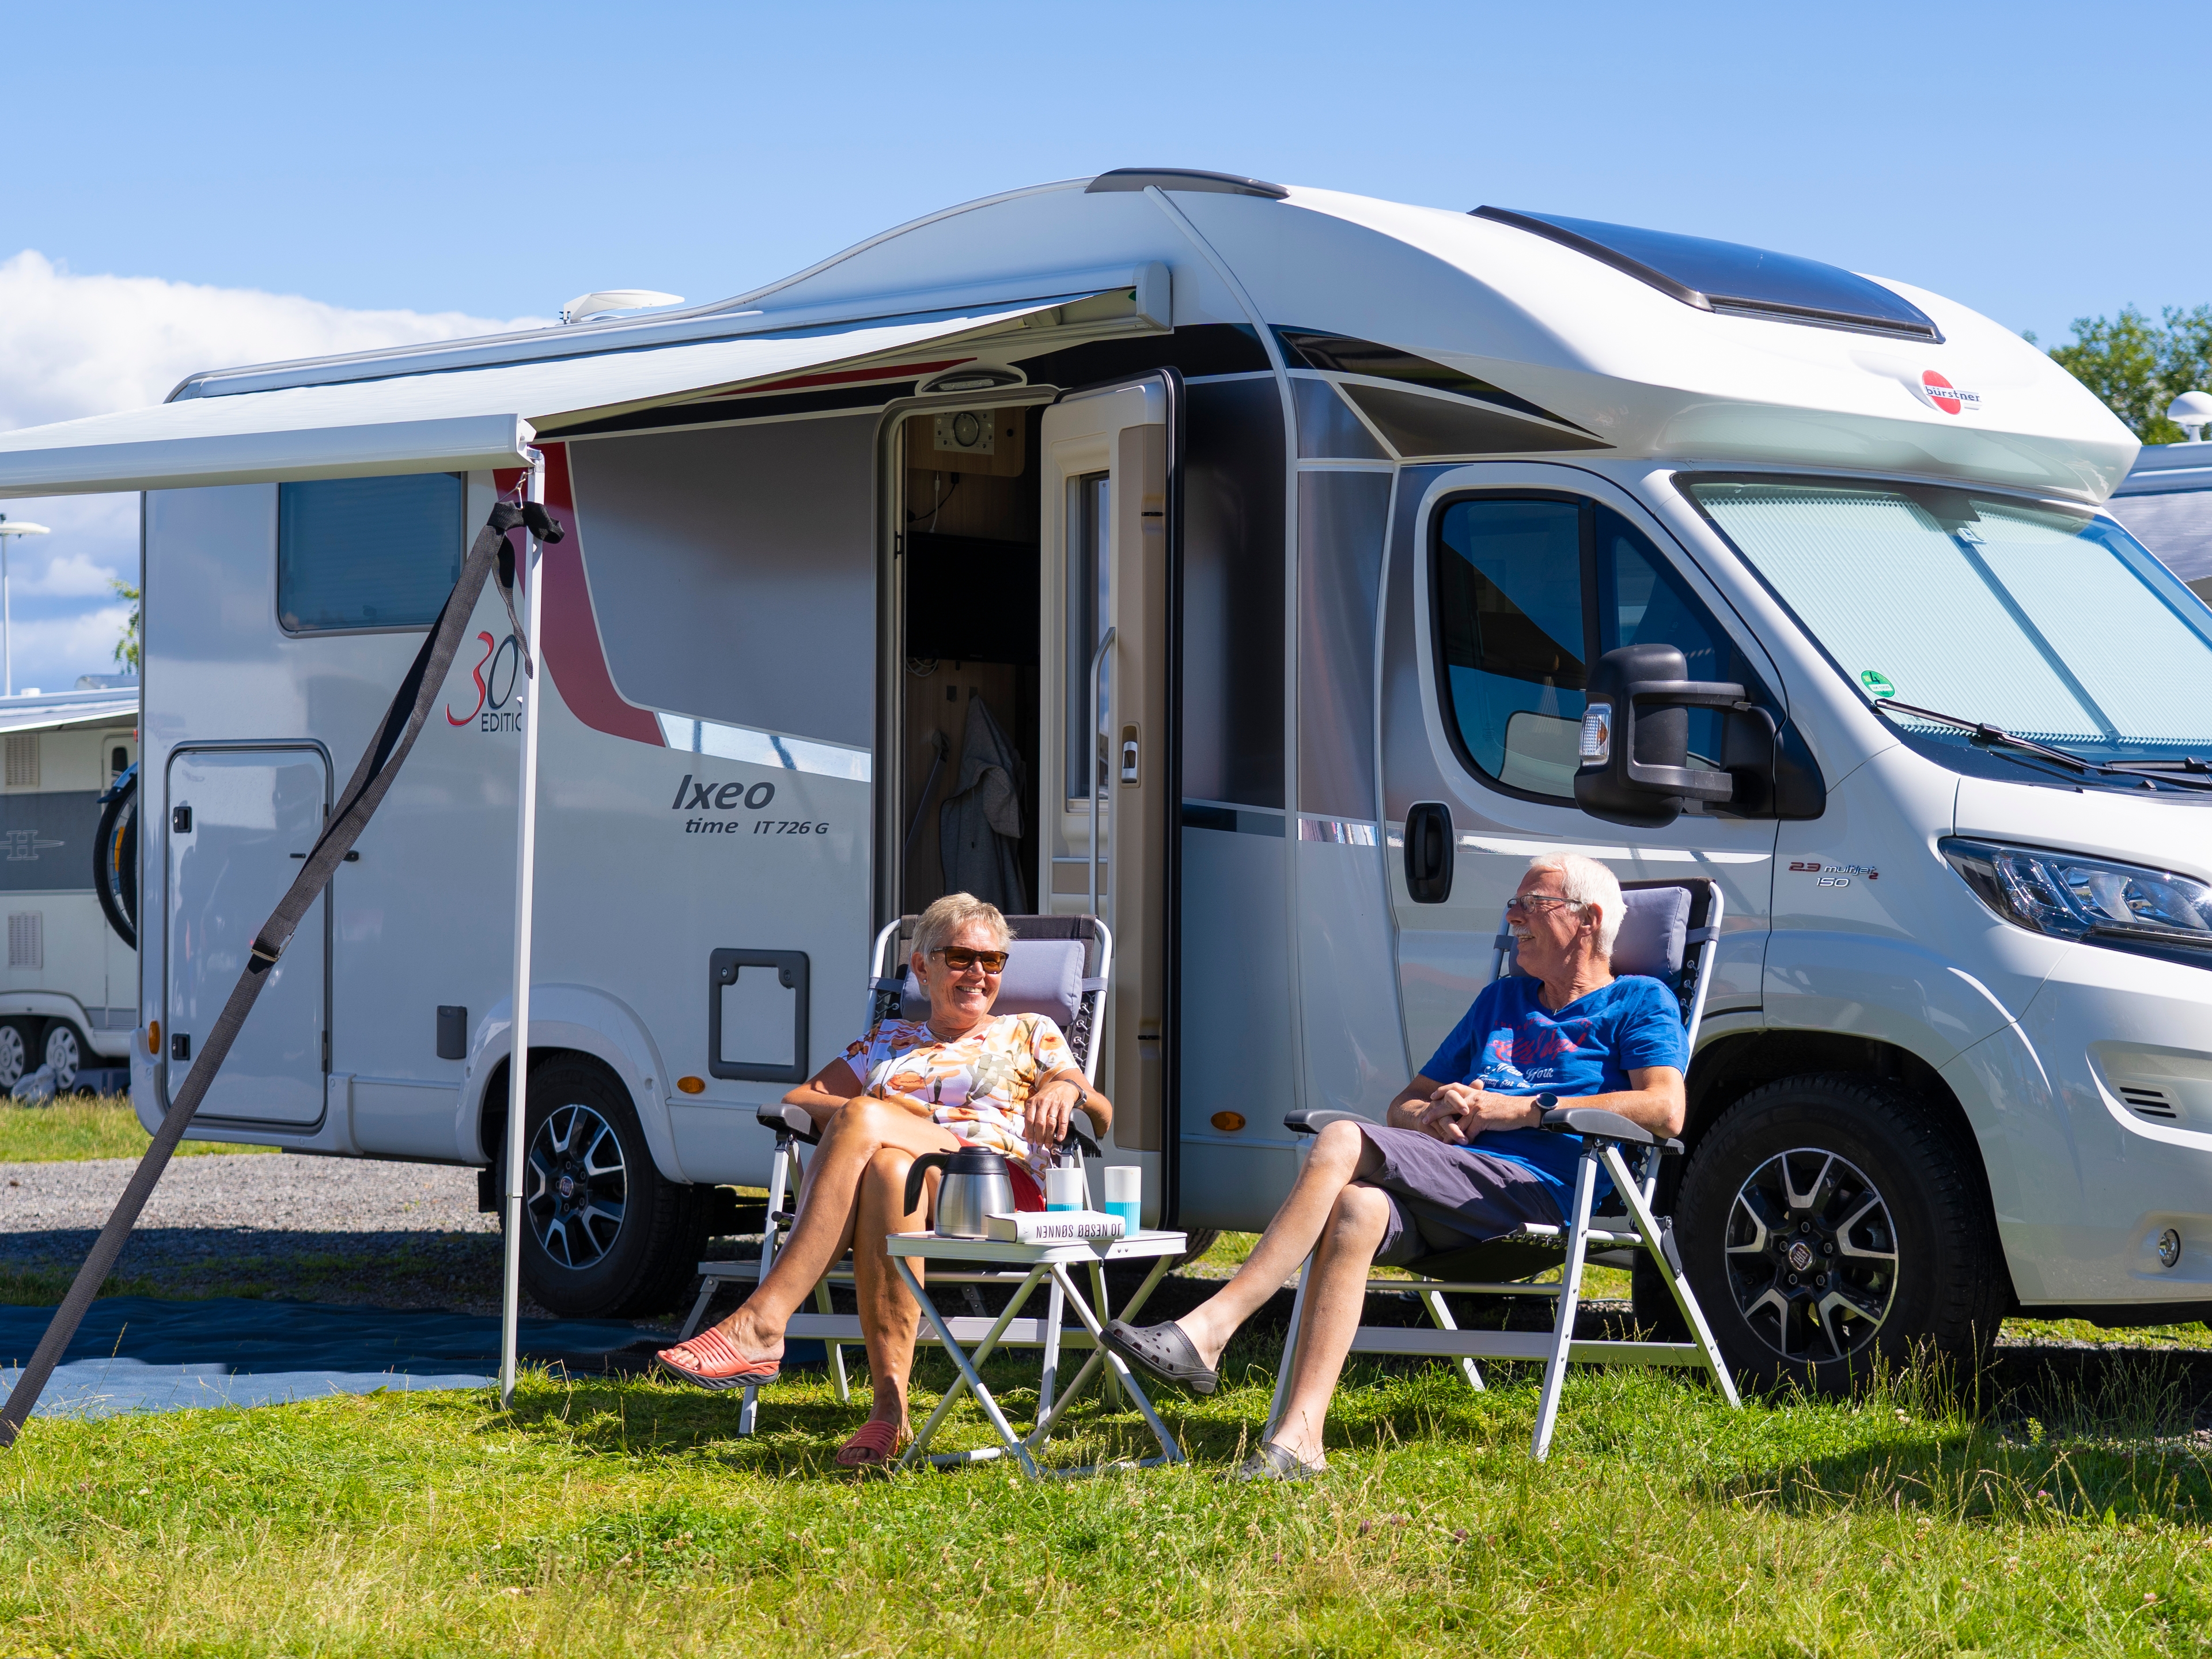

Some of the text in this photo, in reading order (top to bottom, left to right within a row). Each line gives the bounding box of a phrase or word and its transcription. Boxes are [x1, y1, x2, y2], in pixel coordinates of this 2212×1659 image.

[1925, 386, 1980, 402] bürstner
[445, 630, 518, 727] 30
[1869, 672, 1881, 684] 4
[481, 713, 521, 732] EDITI
[672, 774, 775, 810] Ixeo
[685, 817, 739, 834] time
[776, 821, 812, 834] 726
[815, 823, 830, 834] G
[1789, 861, 1821, 873] 2.3
[1816, 877, 1851, 888] 150
[1484, 1062, 1555, 1083] New York
[1036, 1223, 1122, 1238] JO NESBØ SØNNEN
[1793, 1247, 1809, 1267] FIAT
